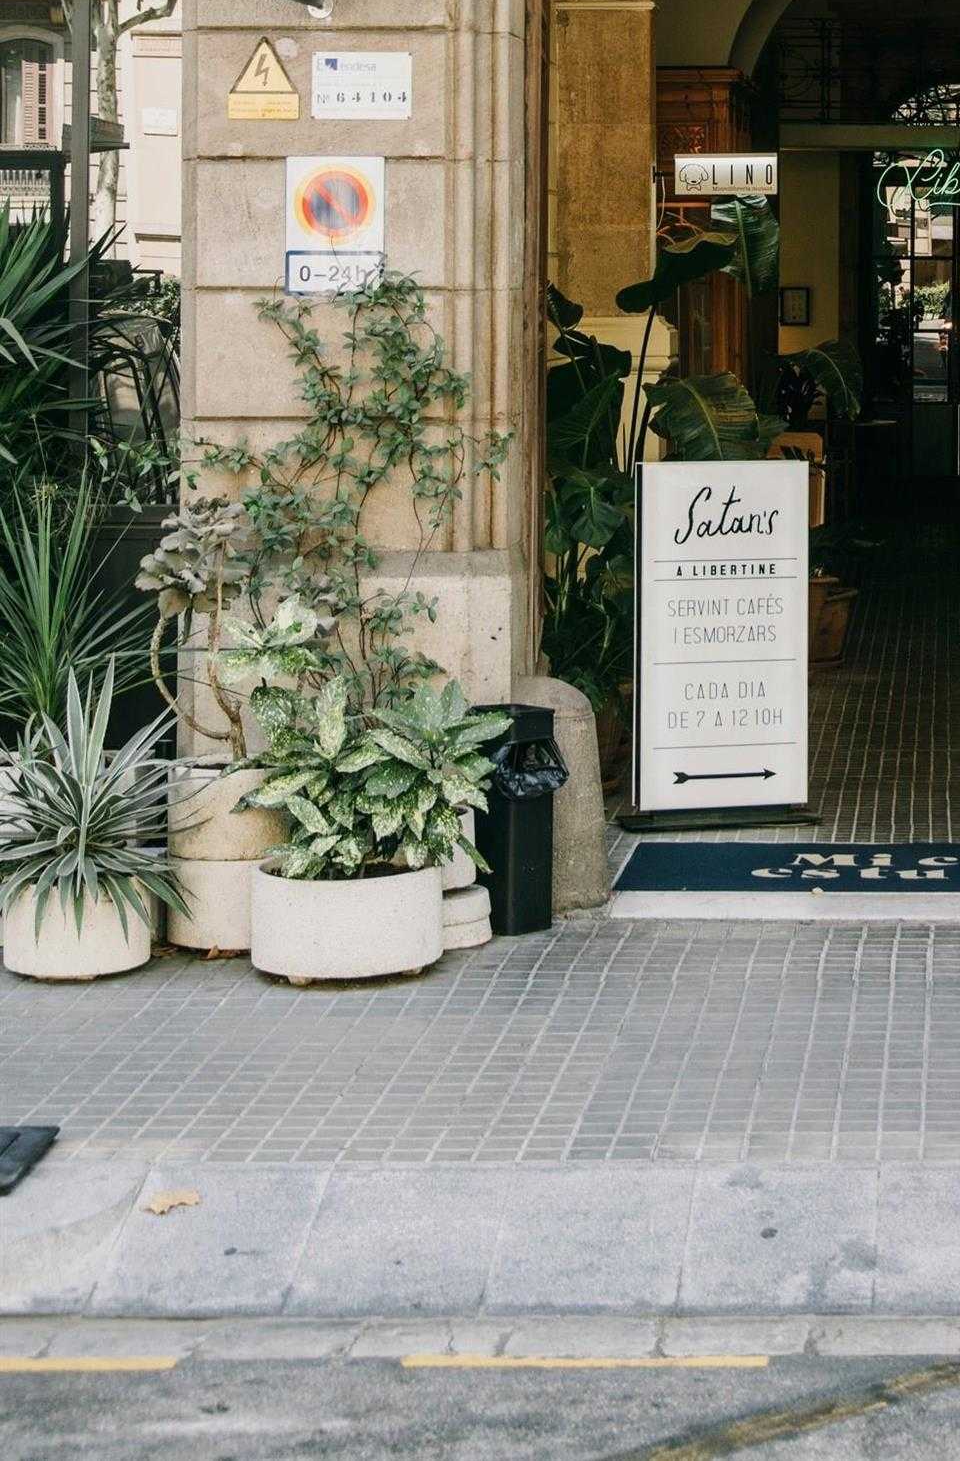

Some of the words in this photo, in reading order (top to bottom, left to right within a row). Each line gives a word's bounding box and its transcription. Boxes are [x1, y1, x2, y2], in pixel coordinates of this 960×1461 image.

[712, 164, 773, 185] LINO
[674, 486, 779, 544] Satan's
[676, 565, 683, 576] A
[693, 563, 776, 576] LIBERTINE
[667, 599, 730, 617] SERVINT
[736, 593, 784, 616] CAFÉS
[683, 625, 777, 644] ESMORZARS
[684, 682, 729, 700] CADA
[738, 681, 766, 699] DIA
[668, 711, 689, 729] DE
[714, 710, 723, 727] A
[791, 852, 893, 867] Mi
[751, 867, 841, 879] es
[860, 867, 949, 879] tu
